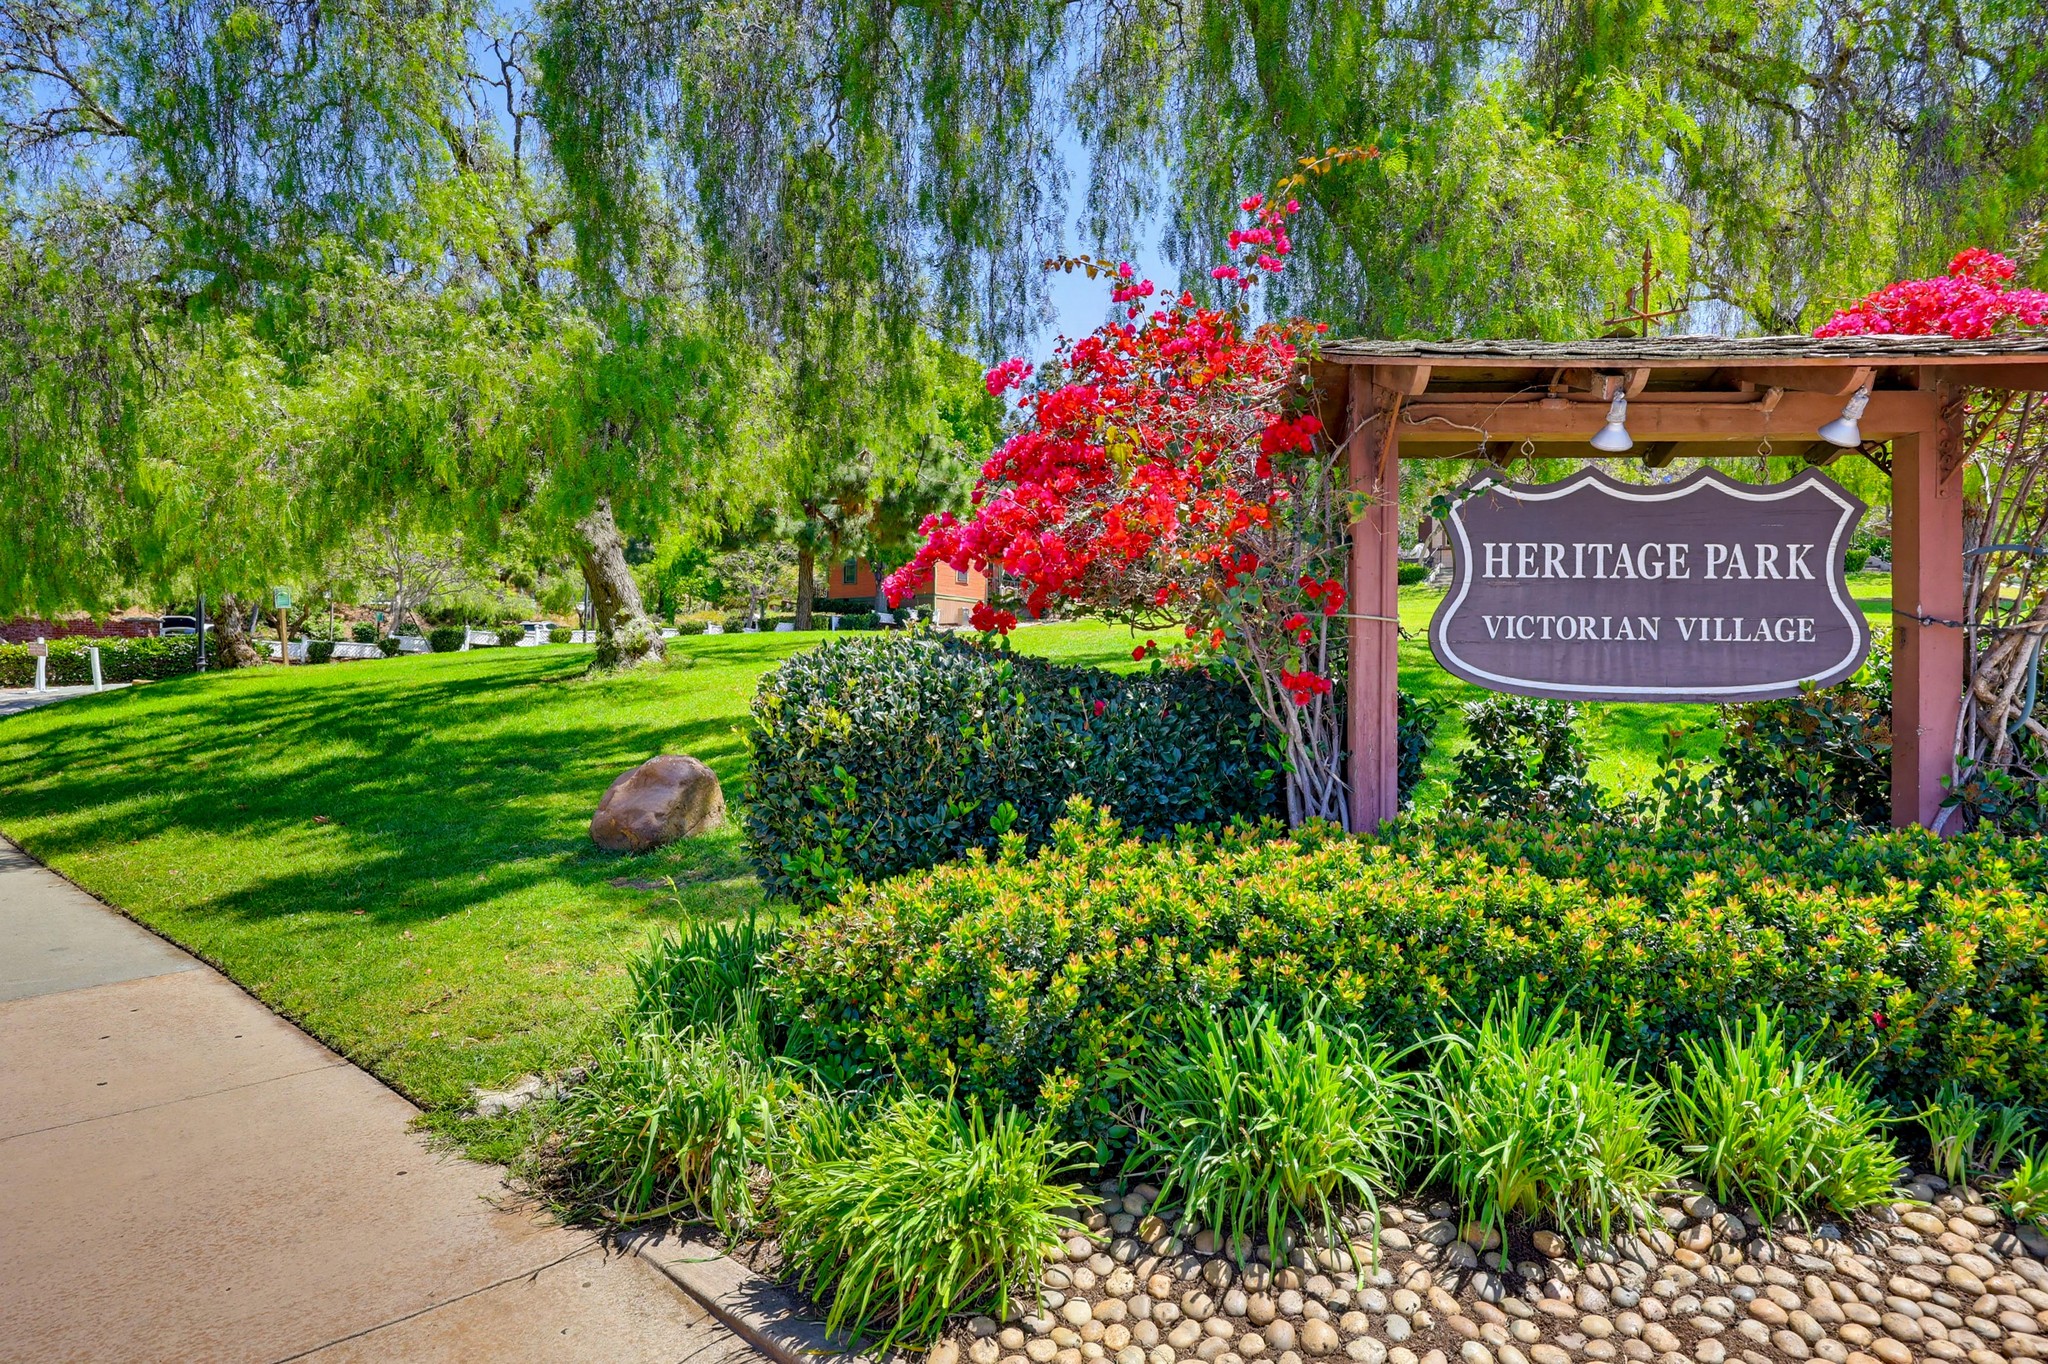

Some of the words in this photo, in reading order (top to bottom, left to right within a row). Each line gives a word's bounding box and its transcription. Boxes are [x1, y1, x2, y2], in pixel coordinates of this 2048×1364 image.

[1482, 542, 1690, 580] HERITAGE
[1704, 543, 1816, 580] PARK
[1481, 615, 1661, 641] VICTORIAN
[1675, 616, 1816, 643] VILLAGE
